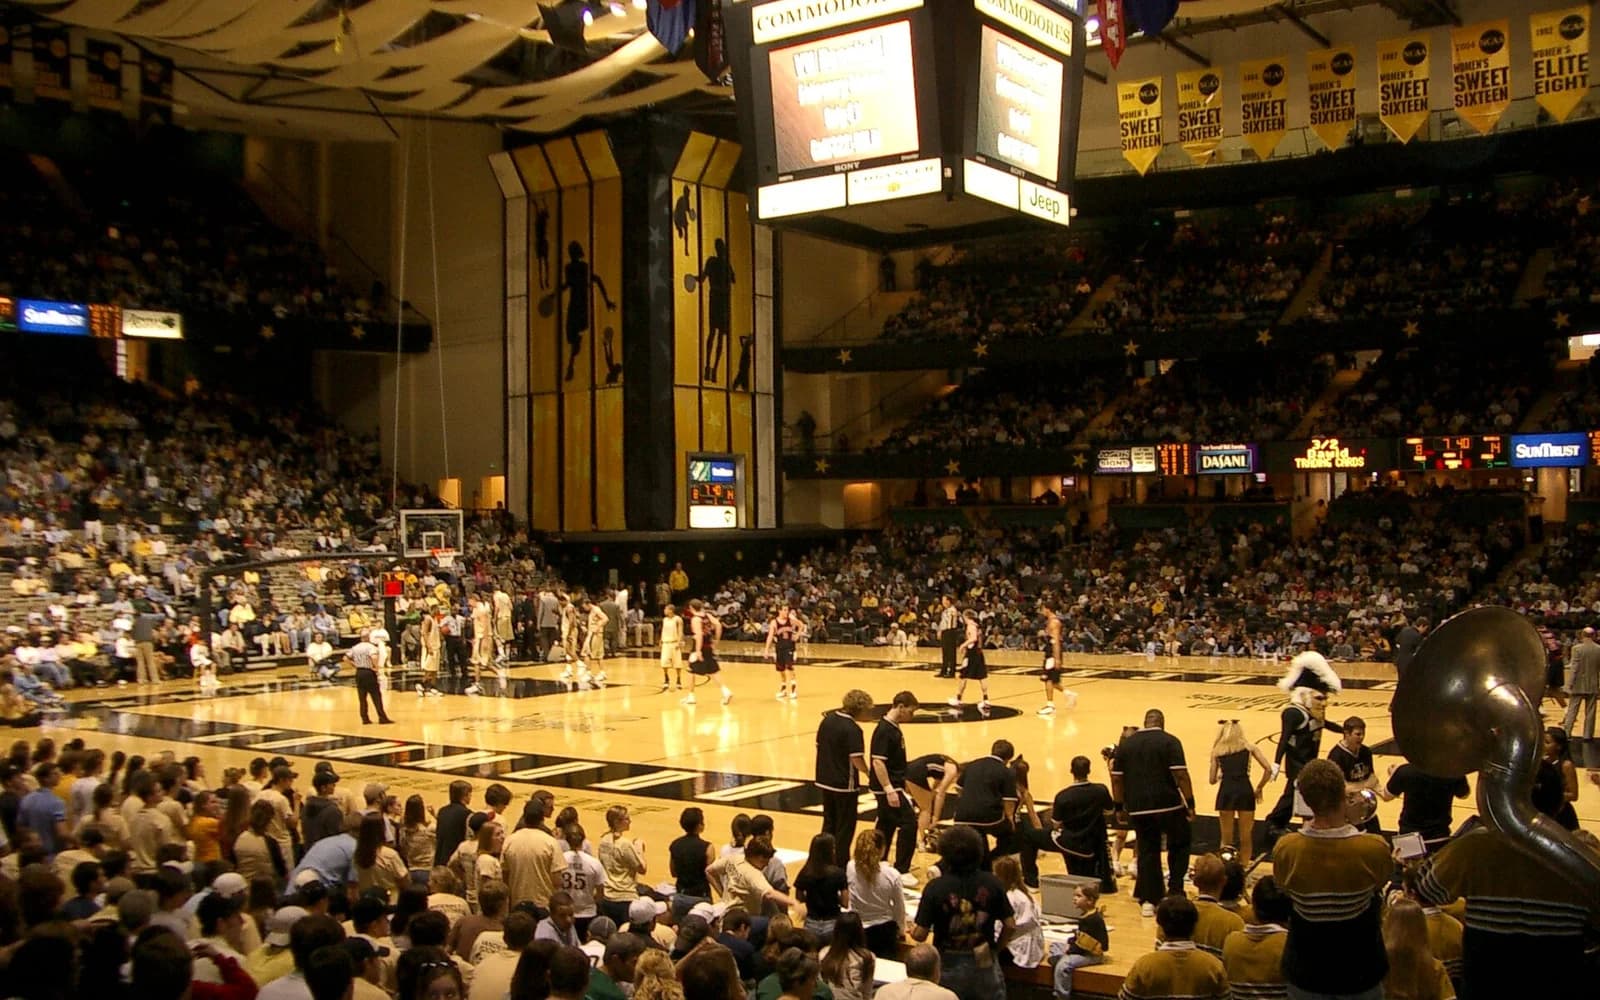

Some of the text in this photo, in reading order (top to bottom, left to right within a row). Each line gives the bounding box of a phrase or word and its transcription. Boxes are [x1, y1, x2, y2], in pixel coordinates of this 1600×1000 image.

[756, 0, 890, 31] COMMODO
[988, 0, 1071, 45] MMODORES
[1534, 53, 1589, 79] ELITE
[1454, 66, 1509, 92] SWEET
[1534, 75, 1588, 95] EIGHT
[1310, 88, 1356, 110] SWEET
[1380, 78, 1430, 101] SWEET
[1454, 86, 1508, 108] SIXTEEN
[1242, 99, 1287, 120] SWEET
[1310, 107, 1356, 125] SIXTEEN
[1381, 97, 1428, 116] SIXTEEN
[1121, 117, 1162, 137] SWEET
[1180, 107, 1222, 129] SWEET
[1243, 117, 1285, 134] SIXTEEN
[1121, 134, 1161, 151] SIXTEEN
[1180, 125, 1222, 143] SIXTEEN
[834, 162, 860, 172] SONY
[1030, 187, 1060, 219] Jeep
[1311, 439, 1339, 450] 3/2
[1202, 454, 1246, 469] DASANI
[561, 872, 586, 890] 35
